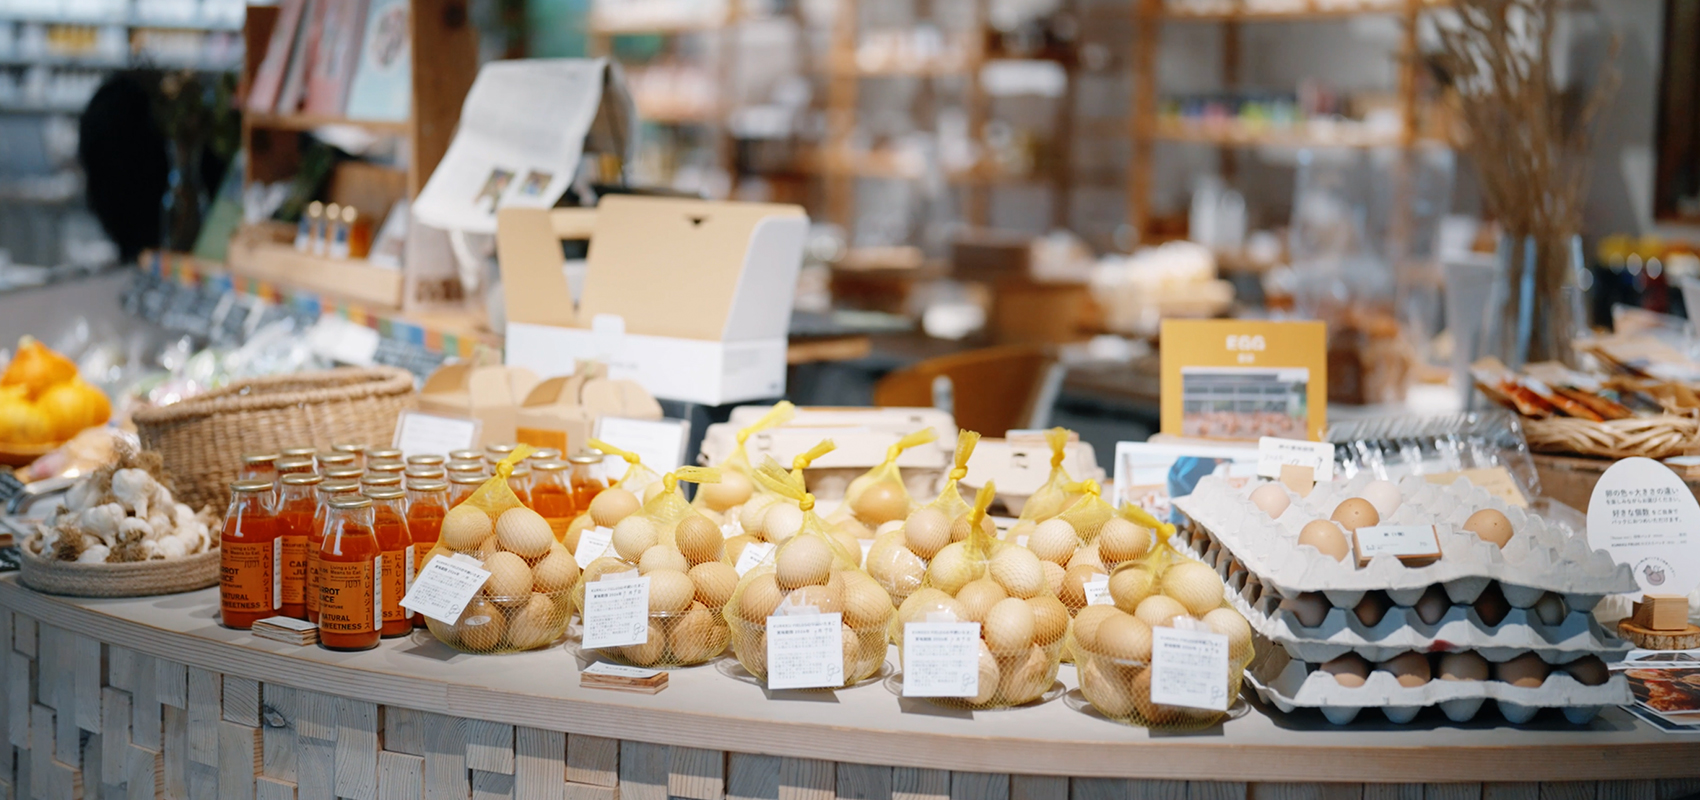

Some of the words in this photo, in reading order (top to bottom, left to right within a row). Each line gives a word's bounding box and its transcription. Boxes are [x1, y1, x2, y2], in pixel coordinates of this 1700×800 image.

[1226, 335, 1266, 351] EGG
[262, 545, 270, 608] にんじんジュース
[322, 612, 350, 622] NATURAL
